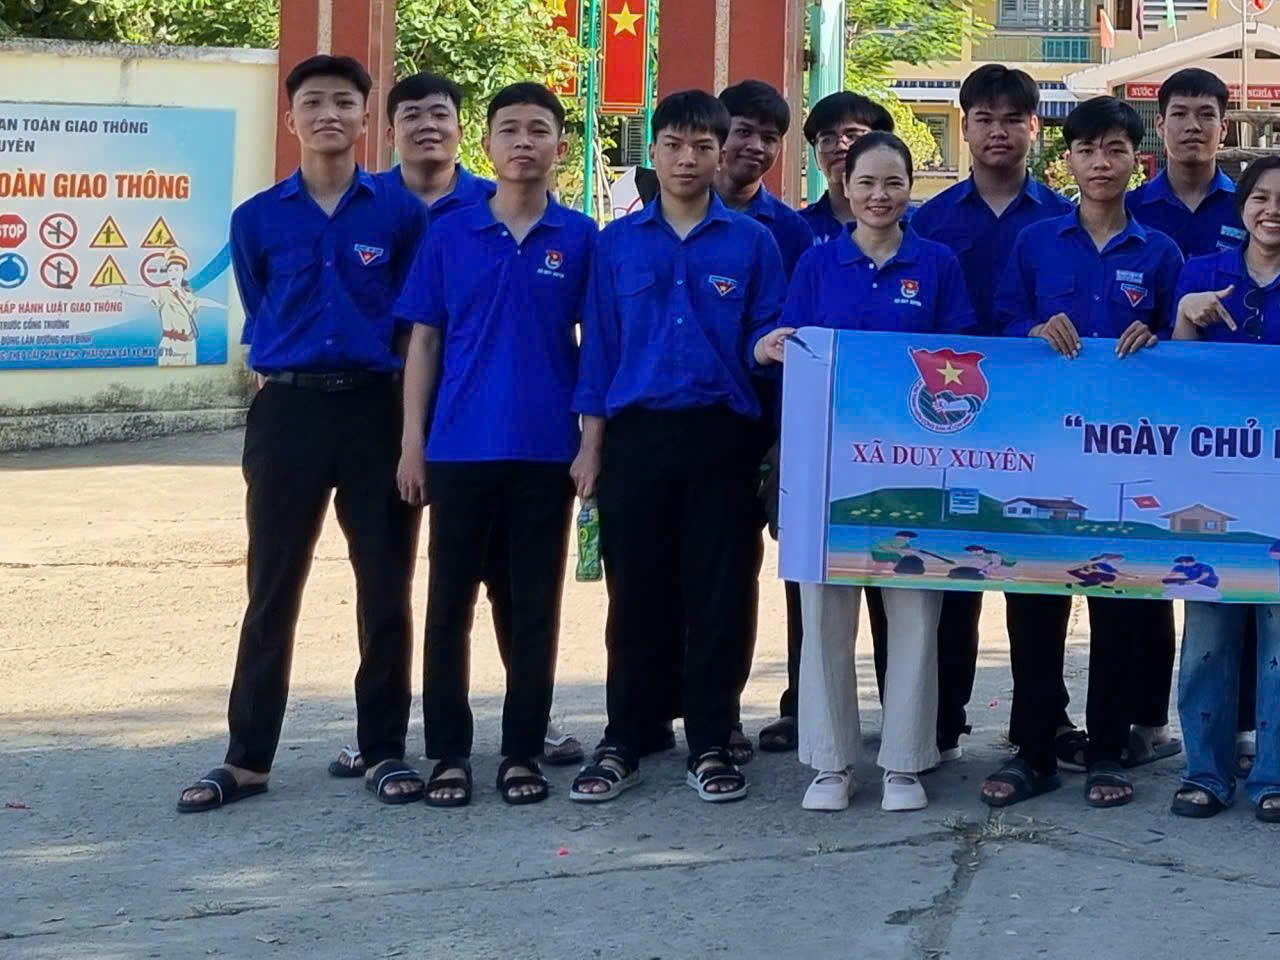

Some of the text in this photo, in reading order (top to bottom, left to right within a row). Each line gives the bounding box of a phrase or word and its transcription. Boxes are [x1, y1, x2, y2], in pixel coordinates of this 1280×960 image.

[0, 116, 149, 134] AN TOÀN GIAO THÔNG
[53, 173, 107, 198] GIAO
[115, 170, 189, 199] THÔNG
[0, 224, 25, 238] TOP
[70, 302, 91, 313] GIAO
[94, 300, 123, 313] THÔNG
[1190, 418, 1262, 458] CHỦ
[853, 440, 1035, 472] XÃ DUY XUYÊN
